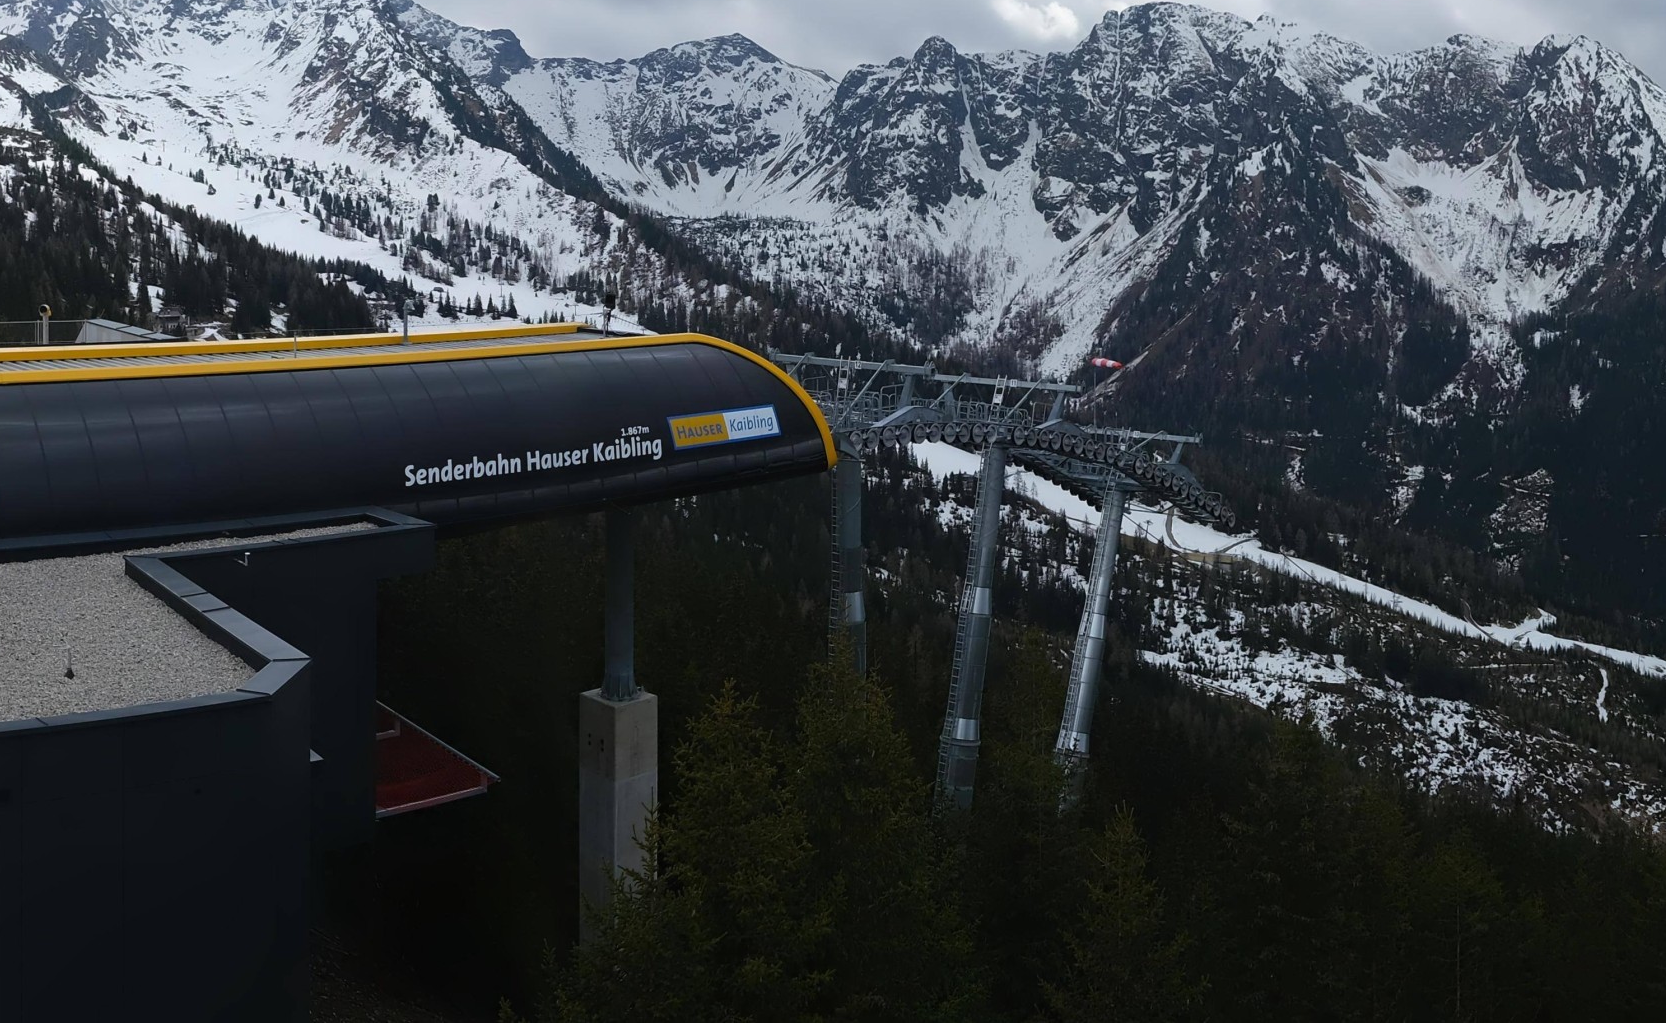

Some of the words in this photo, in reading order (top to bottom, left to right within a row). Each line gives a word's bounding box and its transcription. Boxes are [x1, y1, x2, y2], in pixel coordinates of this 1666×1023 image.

[620, 426, 650, 436] 1.867m
[676, 424, 723, 439] HAUSER
[729, 415, 774, 432] Kaibling
[404, 453, 521, 487] Senderbahn
[526, 446, 589, 471] Hauser
[592, 436, 663, 462] Kaibling
